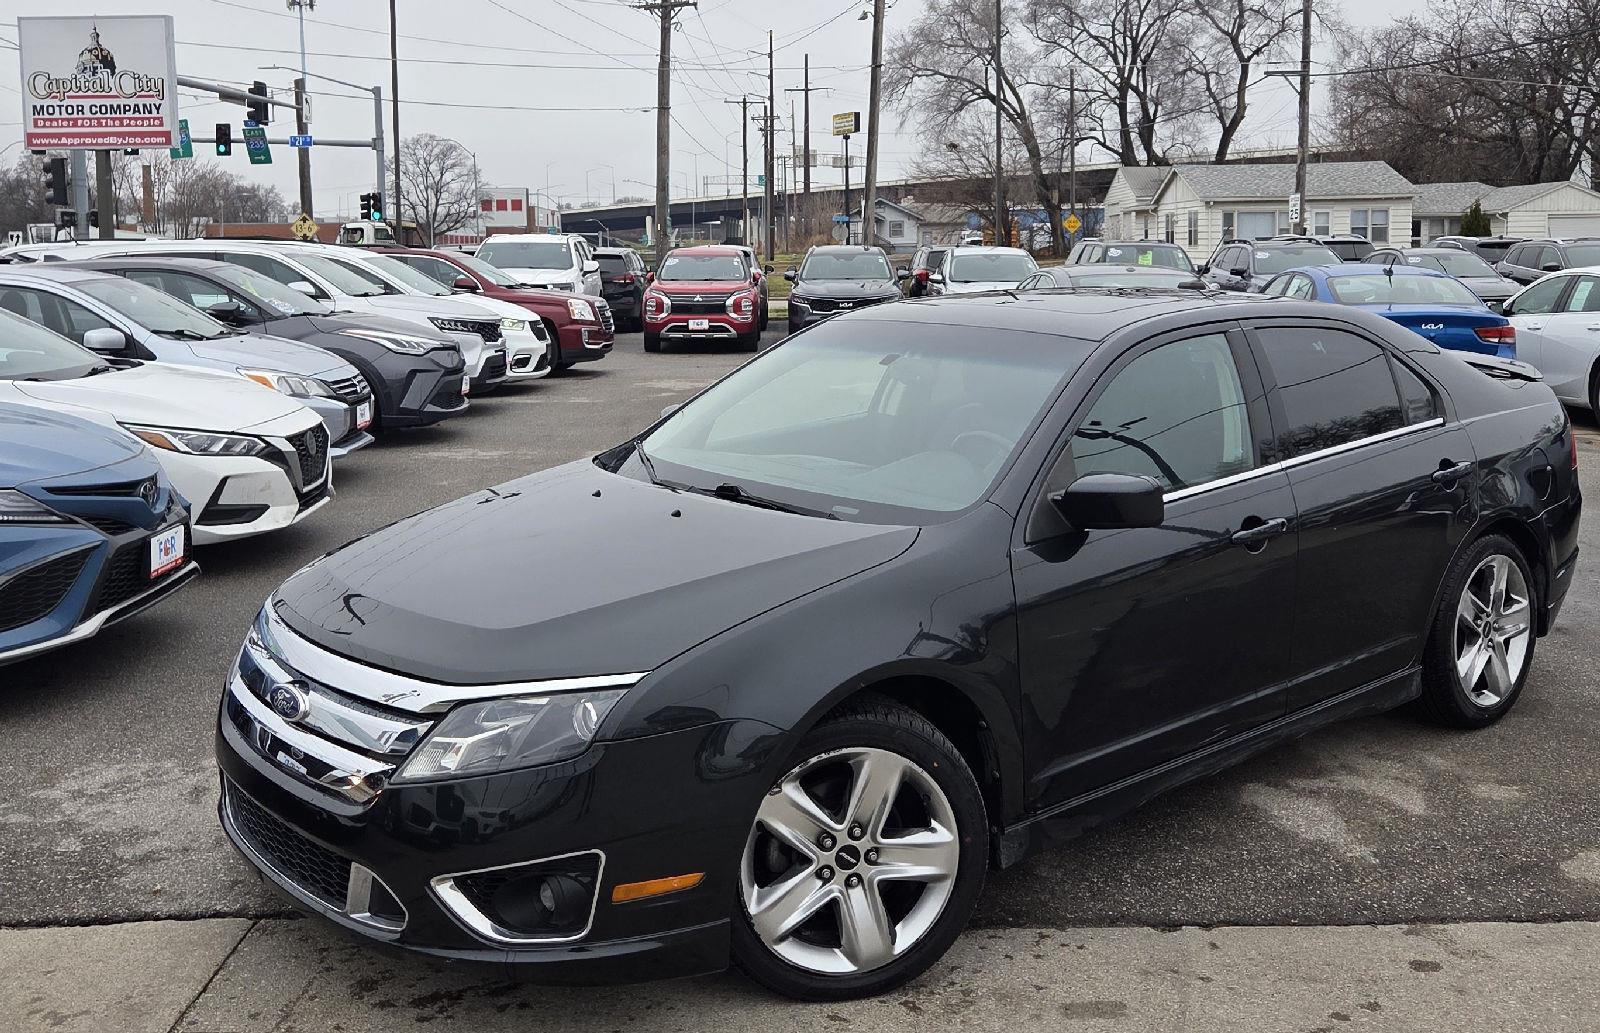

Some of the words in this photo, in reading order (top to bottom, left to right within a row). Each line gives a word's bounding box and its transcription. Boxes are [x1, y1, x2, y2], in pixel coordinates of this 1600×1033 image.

[28, 69, 112, 101] Capital
[114, 70, 164, 100] City
[32, 104, 85, 116] MOTOR
[89, 103, 162, 115] COMPANY
[37, 119, 74, 127] Dealer
[78, 119, 98, 127] FOR
[101, 118, 120, 127] The
[245, 129, 262, 137] EAST
[32, 135, 166, 145] www.ApprovedByJoe.com
[249, 140, 265, 149] 235
[1290, 208, 1299, 220] 25
[273, 689, 294, 713] Ford
